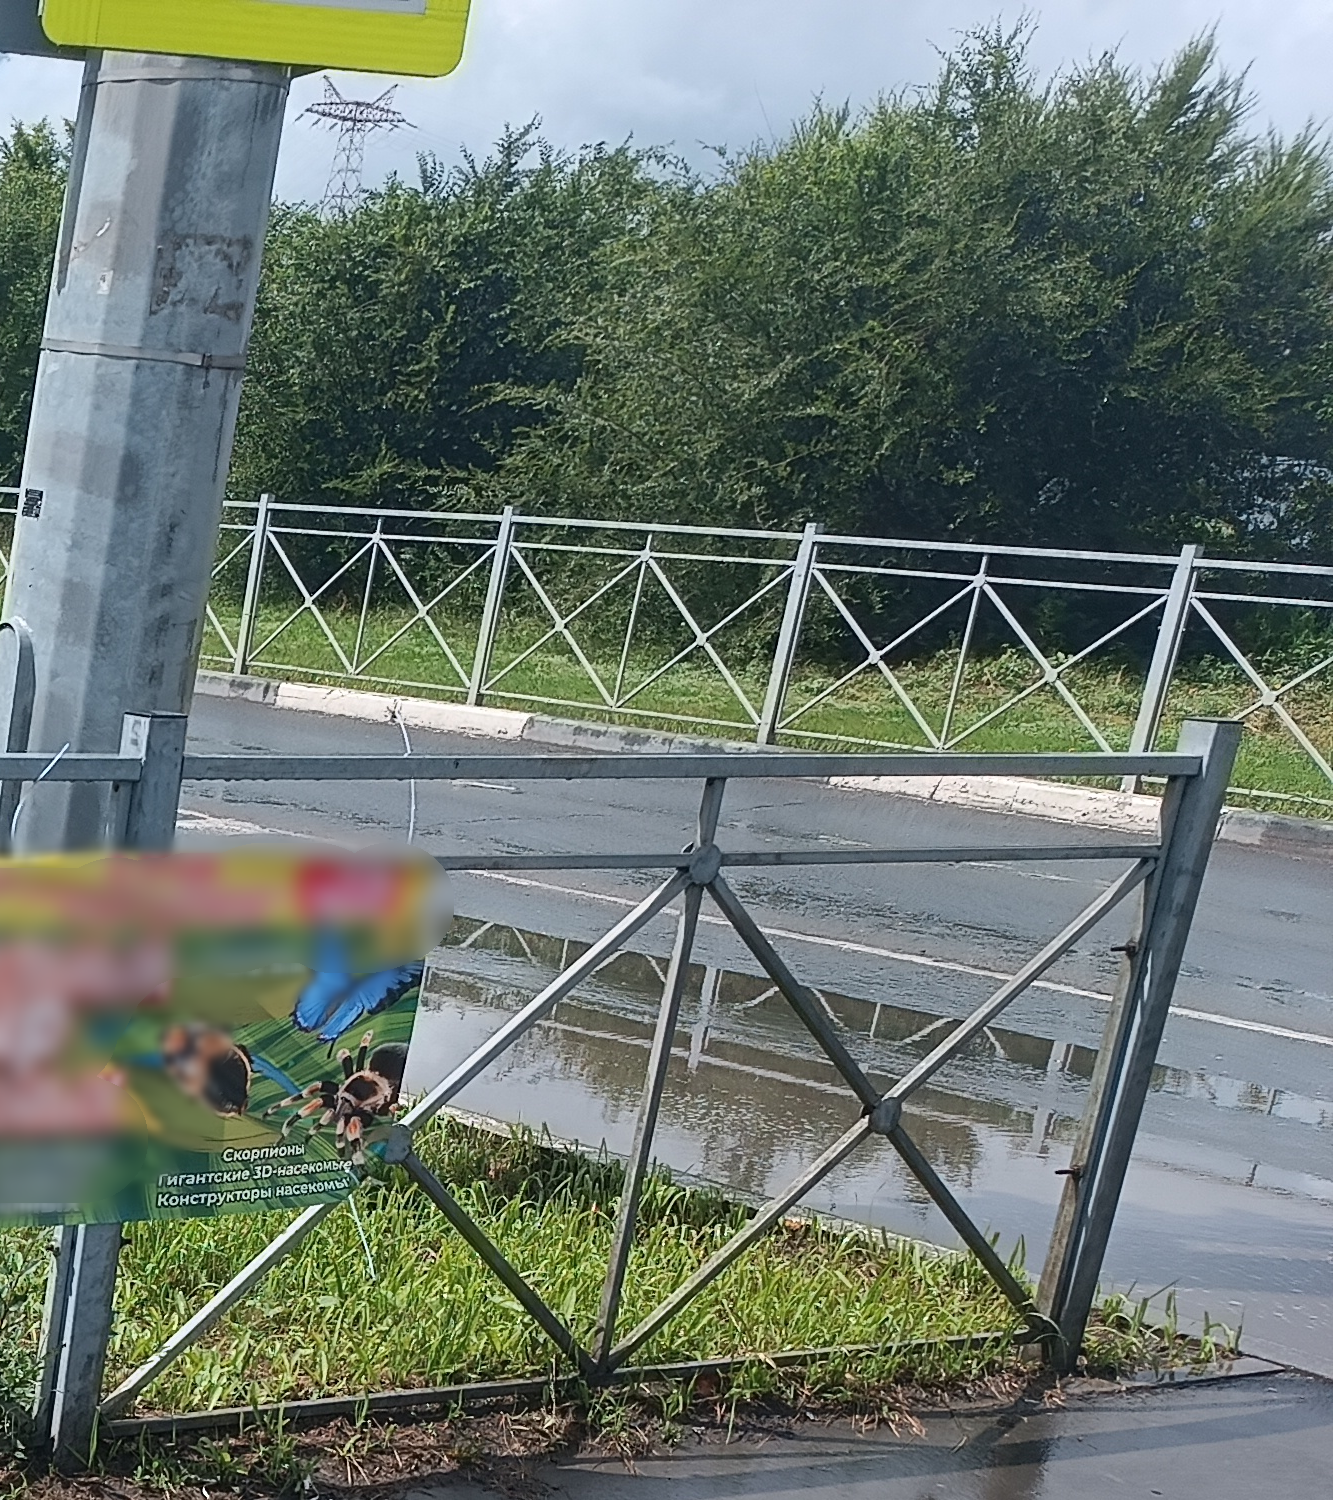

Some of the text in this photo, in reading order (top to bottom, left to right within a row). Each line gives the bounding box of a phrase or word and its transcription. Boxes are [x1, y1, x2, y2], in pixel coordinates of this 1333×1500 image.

[222, 1143, 306, 1164] Скорпионы
[157, 1168, 251, 1188] Гигантские
[156, 1176, 350, 1209] Конструкторы насекомы
